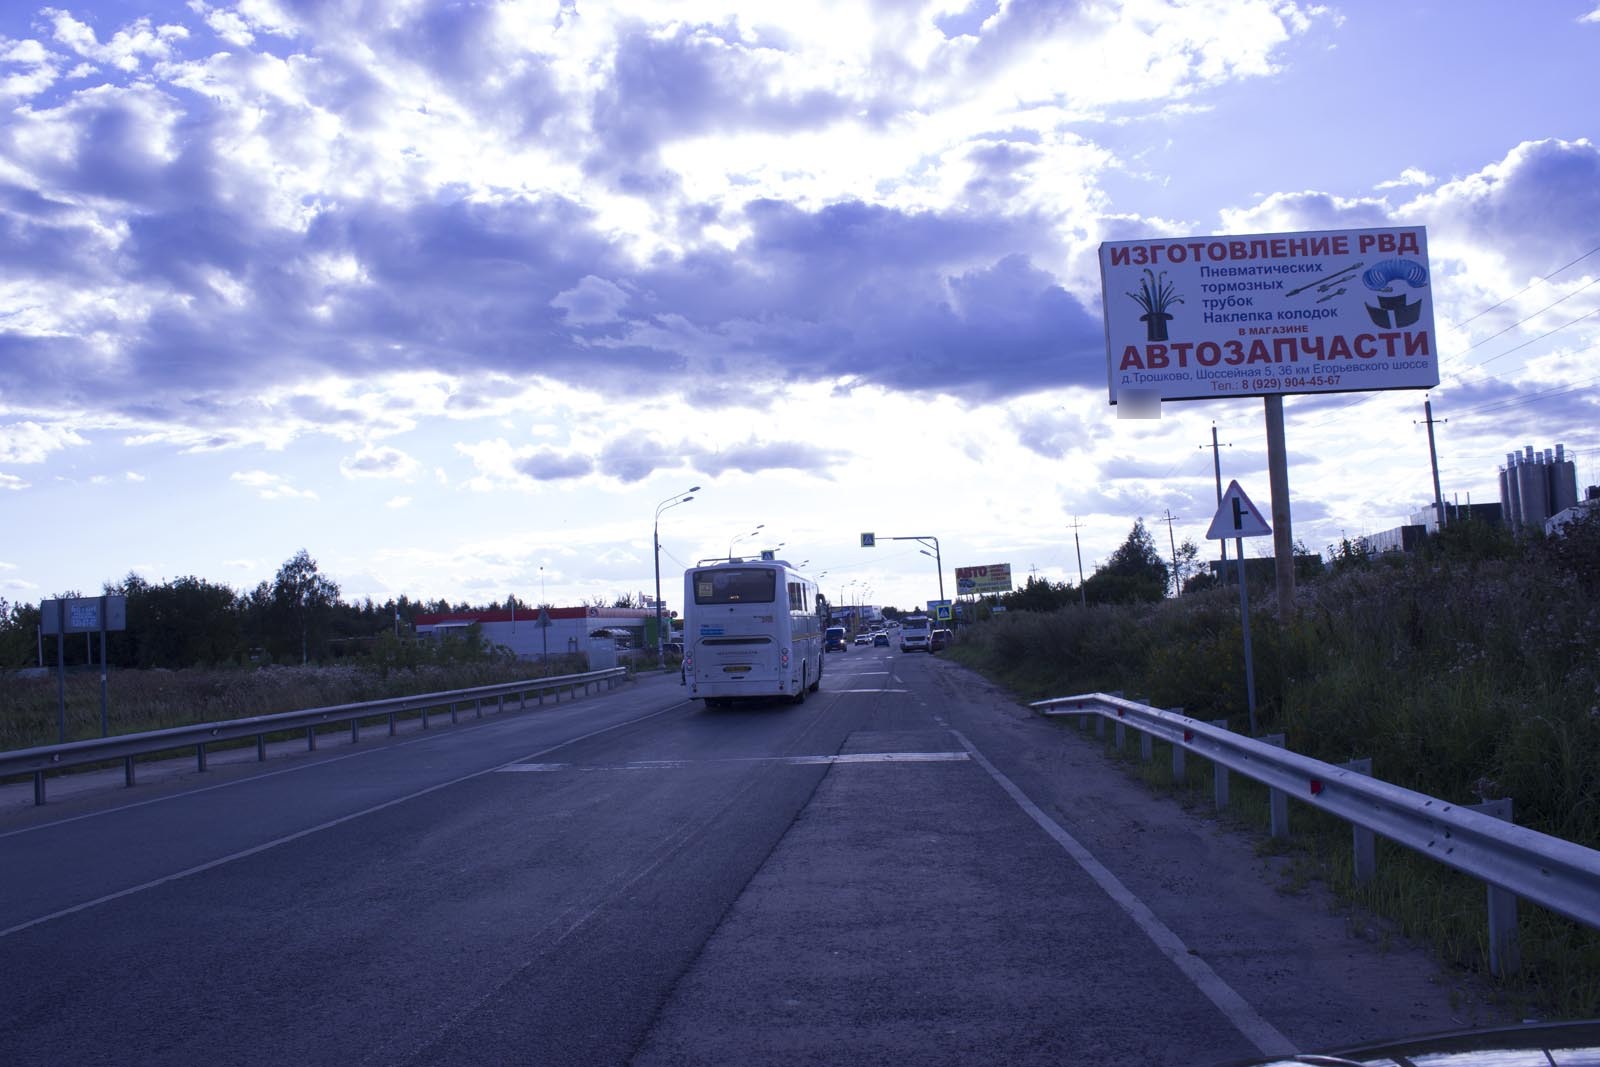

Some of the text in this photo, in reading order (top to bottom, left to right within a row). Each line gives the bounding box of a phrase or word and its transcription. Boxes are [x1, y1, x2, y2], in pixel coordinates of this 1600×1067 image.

[1110, 231, 1420, 266] ИЗГОТОВЛЕНИЕ РВД
[1200, 262, 1323, 278] Пневматических
[1201, 279, 1284, 296] тормозных
[1202, 295, 1254, 311] трубок
[1203, 307, 1338, 324] Наклепка колодок
[1238, 324, 1309, 336] В МАГАЗИНЕ
[1119, 330, 1430, 371] АВТОЗАПЧАСТИ
[1196, 367, 1261, 379] Шоссейная
[1278, 365, 1293, 376] 36
[1295, 367, 1310, 375] км
[1313, 361, 1389, 375] Егорьевского
[1392, 359, 1429, 369] шоссе
[1241, 379, 1249, 390] 8
[1252, 377, 1281, 390] (929)
[1284, 375, 1341, 388] 904-45-67
[957, 566, 987, 578] АВТО
